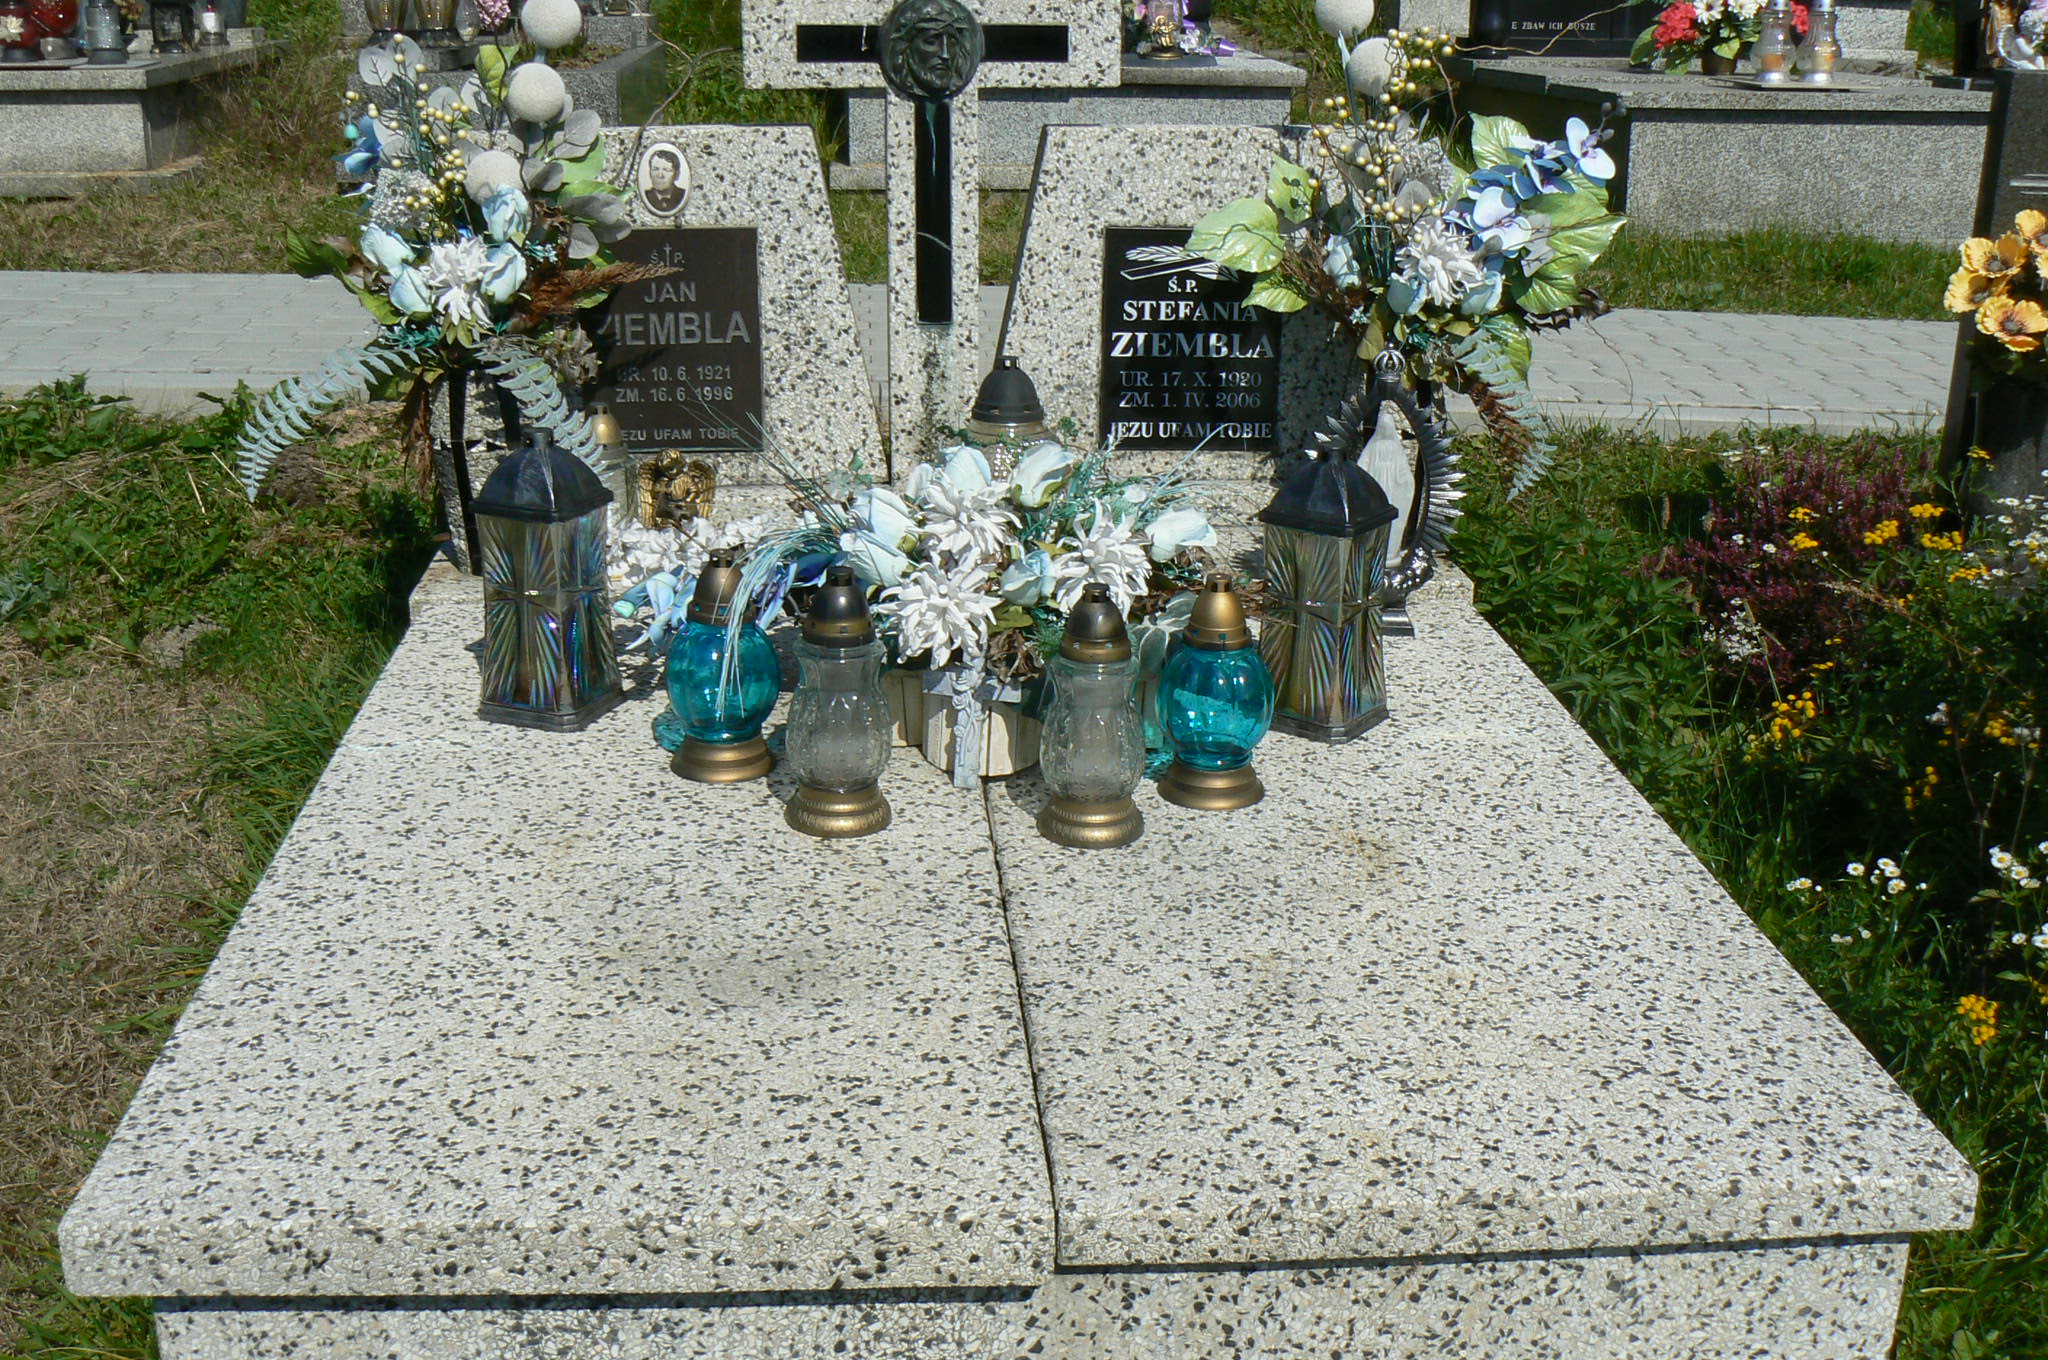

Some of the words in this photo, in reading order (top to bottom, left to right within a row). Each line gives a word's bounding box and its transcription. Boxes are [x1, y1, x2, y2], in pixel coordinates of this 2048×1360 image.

[1521, 21, 1546, 30] ZBAW
[1548, 21, 1564, 30] ICH
[644, 281, 697, 304] JAN
[1167, 276, 1182, 293] Ś.
[1185, 279, 1198, 293] P.
[1123, 300, 1260, 322] STEFANIA
[1110, 331, 1276, 359] ZIEMBLA
[652, 366, 673, 382] 10.
[697, 365, 732, 381] 1921
[1120, 371, 1154, 388] UR.
[1161, 371, 1187, 388] 17.
[1194, 371, 1212, 388] X.
[1219, 371, 1263, 388] 1920
[615, 388, 645, 403] ZM.
[650, 387, 673, 402] 16.
[695, 386, 734, 402] 1996
[1119, 392, 1155, 408] ZM.
[1162, 392, 1177, 408] 1.
[1184, 392, 1209, 408] IV.
[1215, 391, 1262, 408] 2006
[620, 429, 647, 441] EZU
[654, 428, 692, 441] UFAM
[700, 427, 739, 440] TOBIE
[1110, 422, 1153, 439] JEZU
[1158, 422, 1212, 439] UFAM
[1217, 423, 1273, 439] TOBIE
